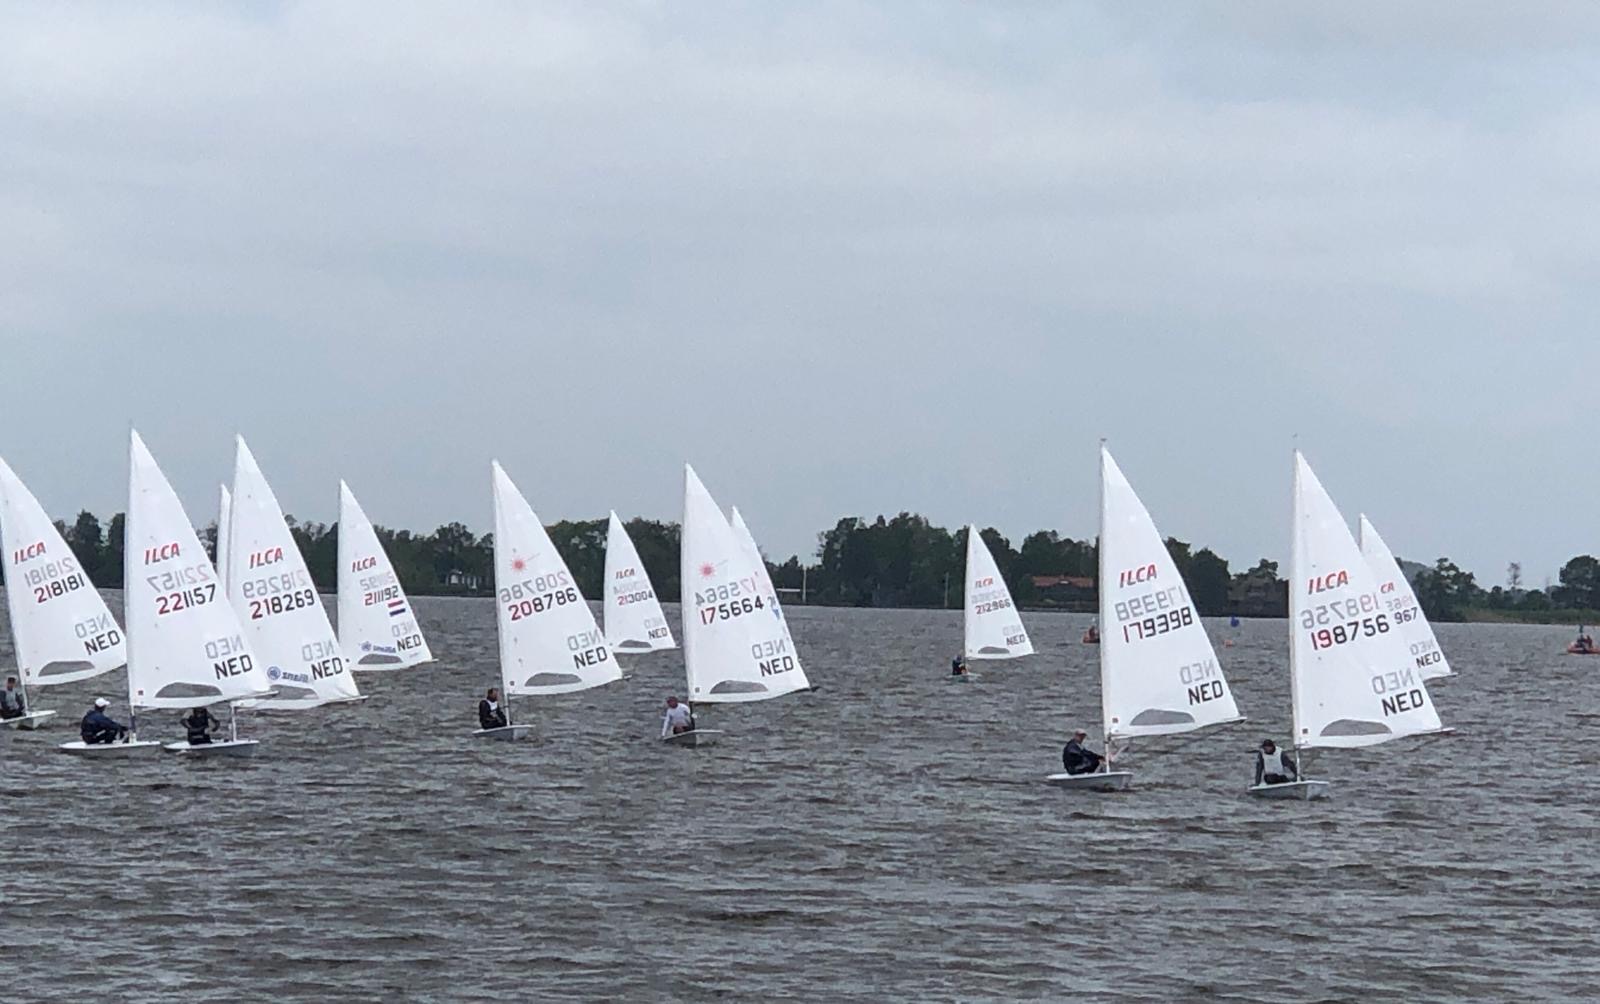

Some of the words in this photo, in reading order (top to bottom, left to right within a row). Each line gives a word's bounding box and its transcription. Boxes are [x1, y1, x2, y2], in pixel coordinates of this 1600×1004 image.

[15, 542, 46, 564] ILCA
[145, 543, 180, 565] ILCA
[250, 548, 284, 569] ILCA
[352, 557, 376, 572] ILCA
[616, 568, 635, 579] ILCA
[1120, 564, 1157, 588] ILCA
[1308, 570, 1348, 595] ILCA
[34, 573, 85, 603] 218181
[156, 584, 216, 615] 221157
[365, 586, 398, 606] 211192
[1380, 582, 1394, 594] CA
[250, 589, 314, 619] 218269
[508, 588, 577, 621] 208786
[701, 595, 764, 625] 175664
[1394, 607, 1417, 624] 967
[648, 627, 668, 639] NED
[1123, 606, 1192, 643] 179398
[1311, 614, 1390, 650] 198756
[84, 630, 120, 655] NED
[397, 634, 421, 652] NED
[214, 655, 252, 680] NED
[311, 657, 343, 680] NED
[574, 646, 607, 669] NED
[760, 656, 794, 677] NED
[1416, 652, 1440, 668] NED
[1188, 680, 1224, 705] NED
[1382, 689, 1424, 716] NED
